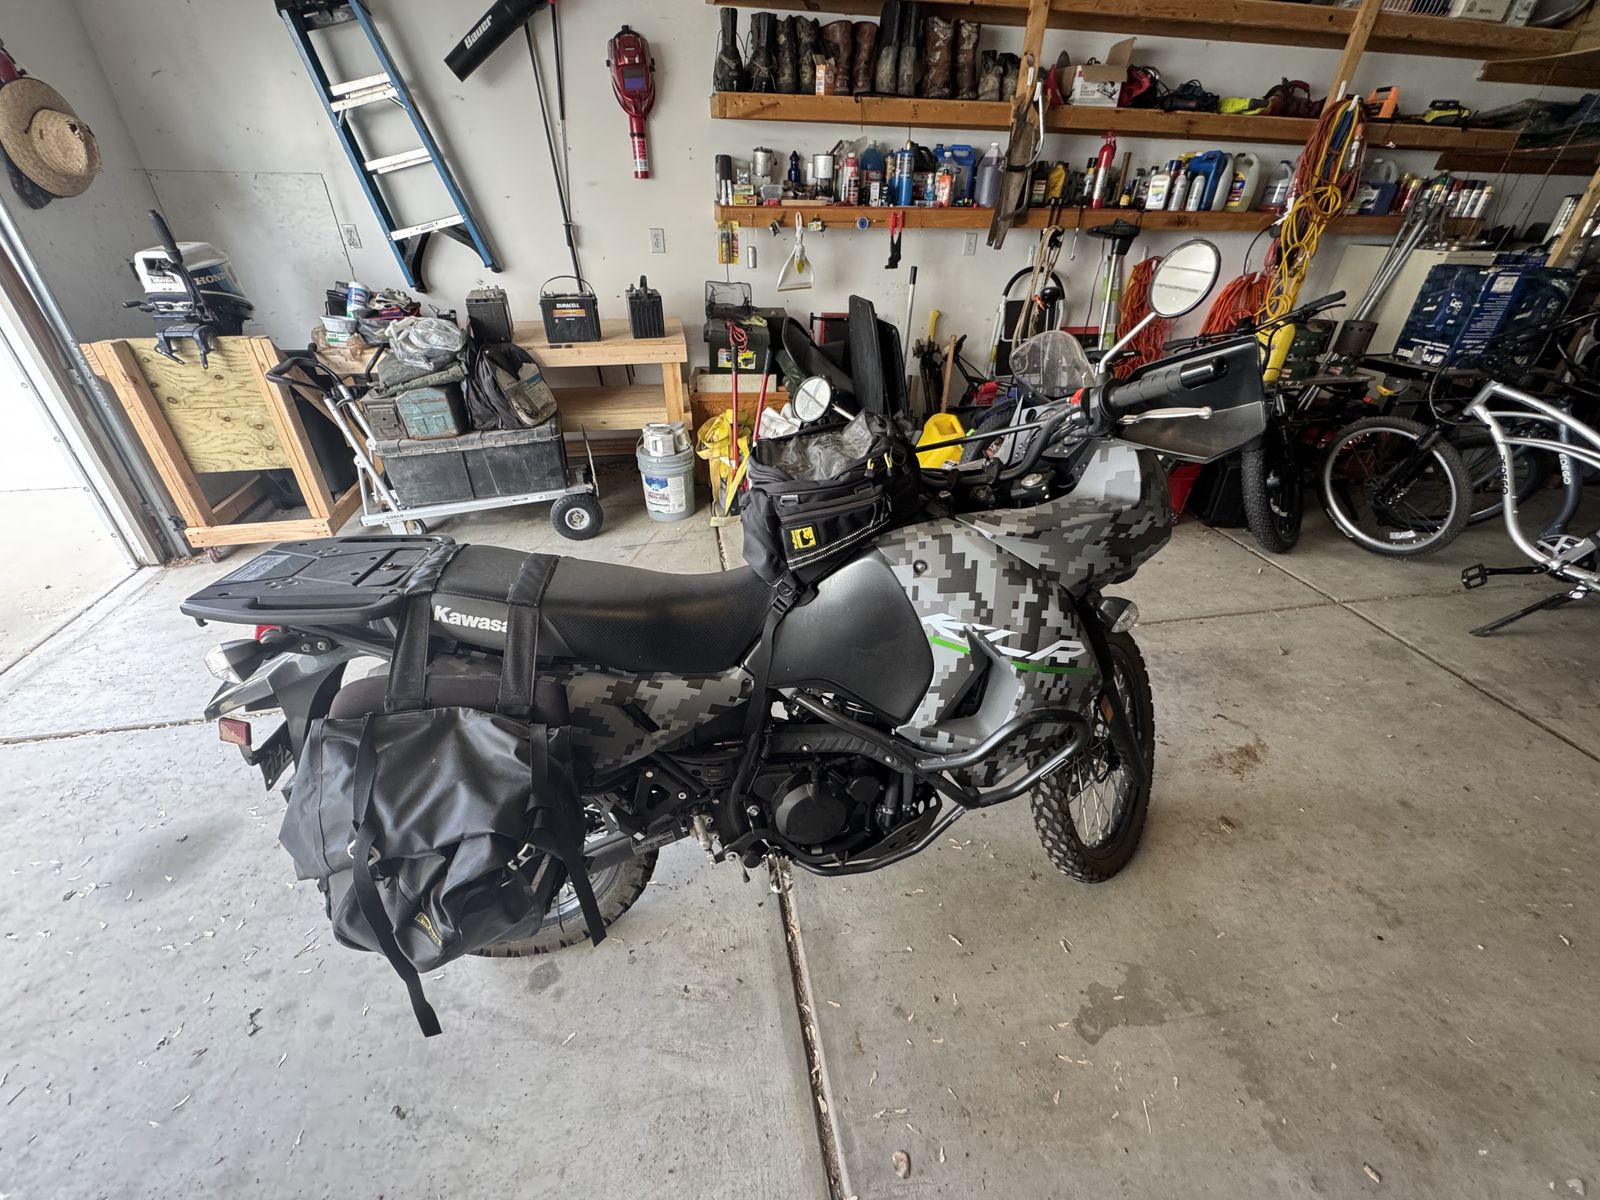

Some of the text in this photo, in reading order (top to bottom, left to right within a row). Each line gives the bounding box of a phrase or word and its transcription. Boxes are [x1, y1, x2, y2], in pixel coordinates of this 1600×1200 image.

[463, 14, 493, 50] Bauer
[193, 271, 227, 286] HOND
[1559, 453, 1572, 485] EDEGO
[433, 605, 508, 633] Kawasa
